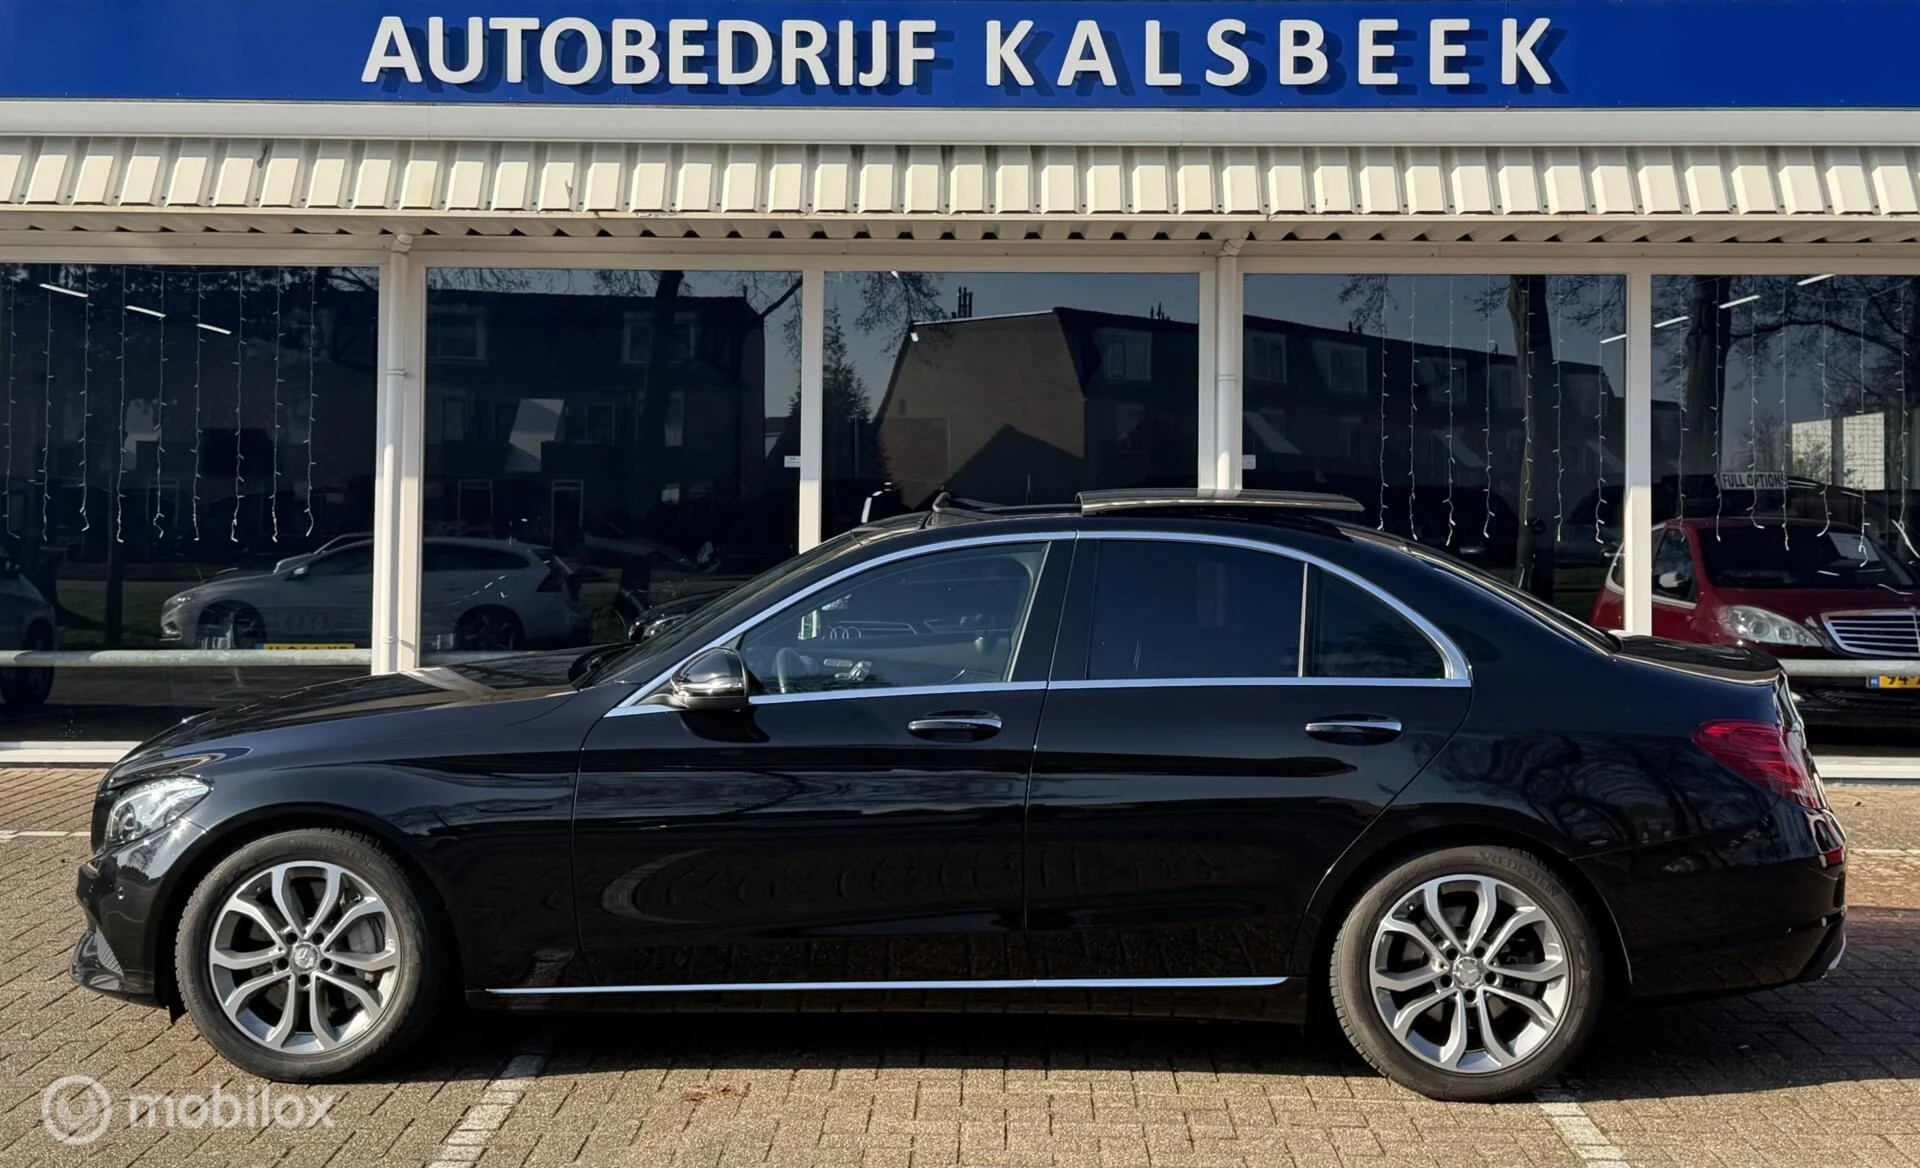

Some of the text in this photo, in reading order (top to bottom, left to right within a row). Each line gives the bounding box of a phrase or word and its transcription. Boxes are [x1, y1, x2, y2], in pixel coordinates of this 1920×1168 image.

[361, 16, 1552, 87] AUTOBEDRIJF KALSBEEK
[1722, 473, 1746, 487] FULL
